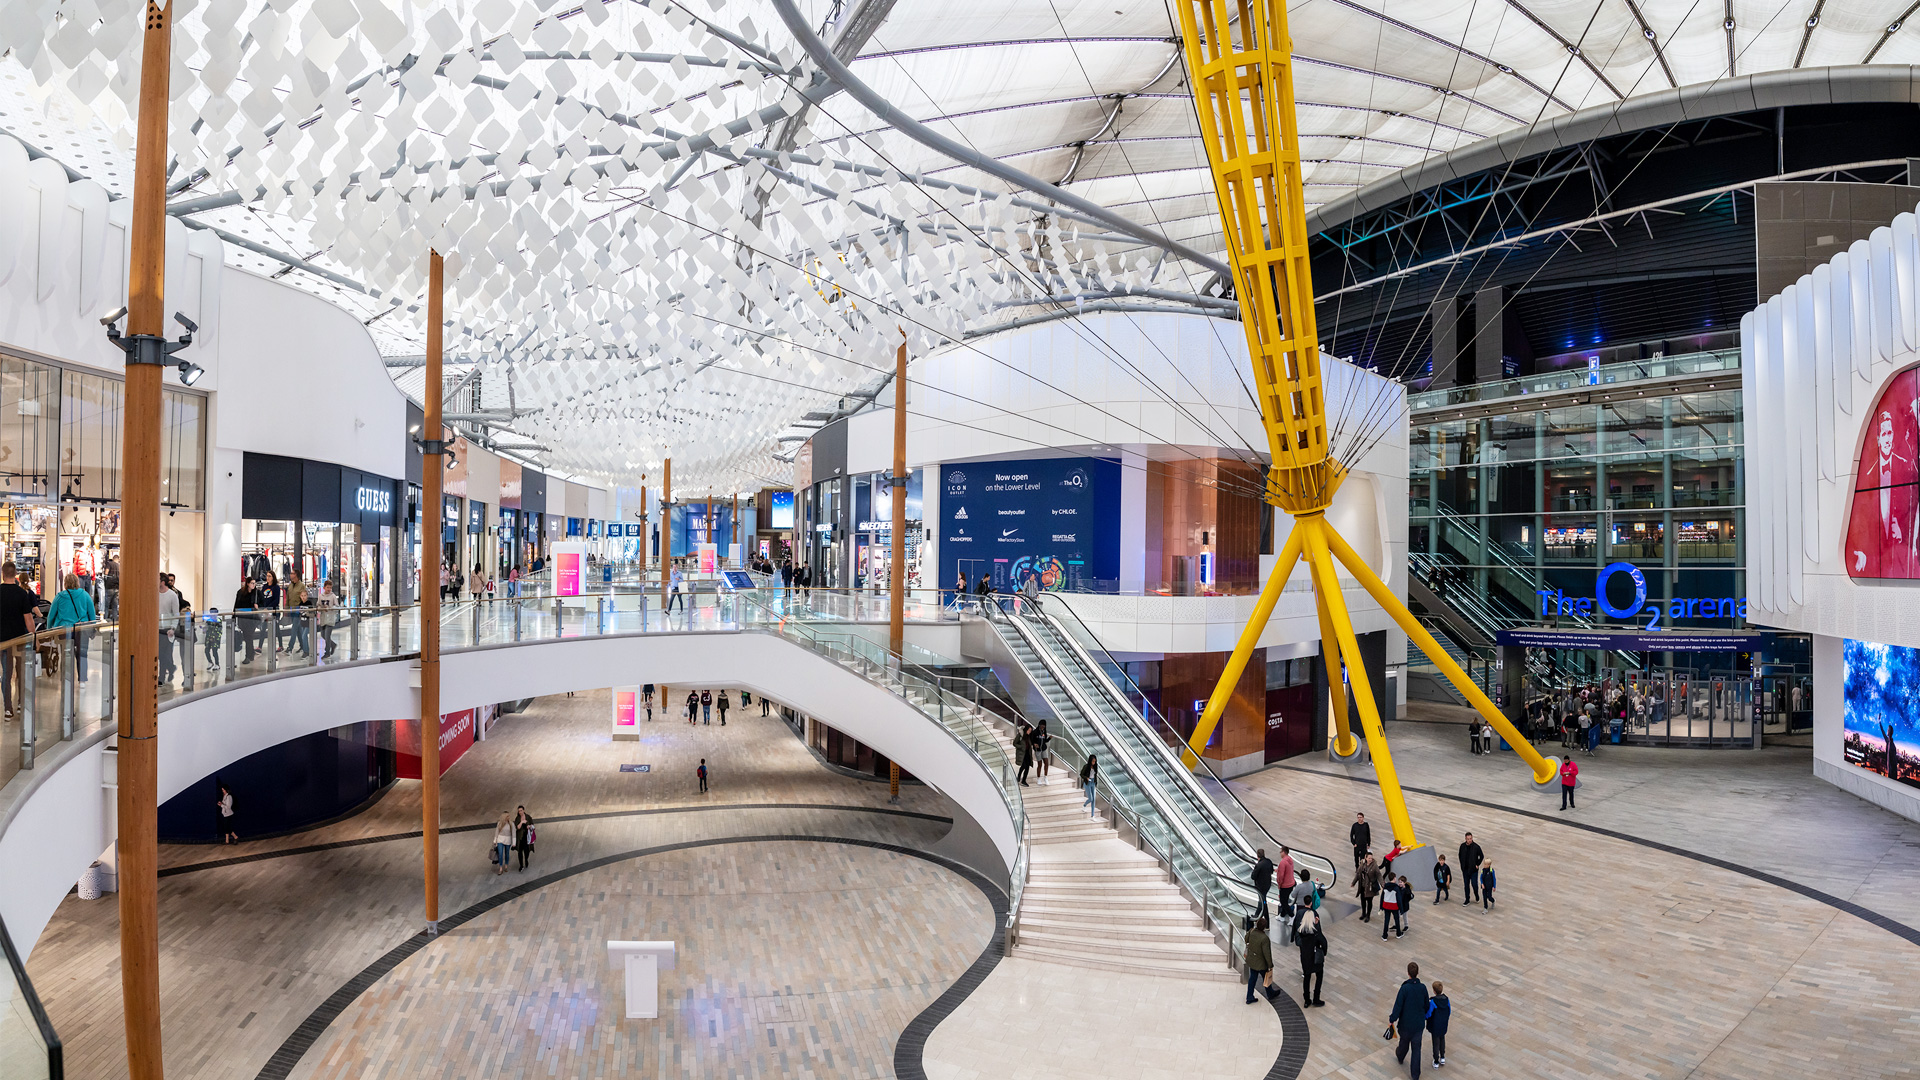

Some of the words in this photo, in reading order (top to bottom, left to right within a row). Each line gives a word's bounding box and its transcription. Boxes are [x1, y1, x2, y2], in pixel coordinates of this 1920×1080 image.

[1012, 474, 1028, 482] open
[1025, 482, 1040, 490] Level
[357, 487, 389, 513] GUESS
[859, 521, 892, 531] SKECHER
[1537, 589, 1592, 618] The
[1496, 660, 1503, 670] H
[1754, 668, 1762, 678] H
[1268, 717, 1283, 726] COSTA
[439, 723, 458, 751] COMING
[457, 713, 470, 735] SOON
